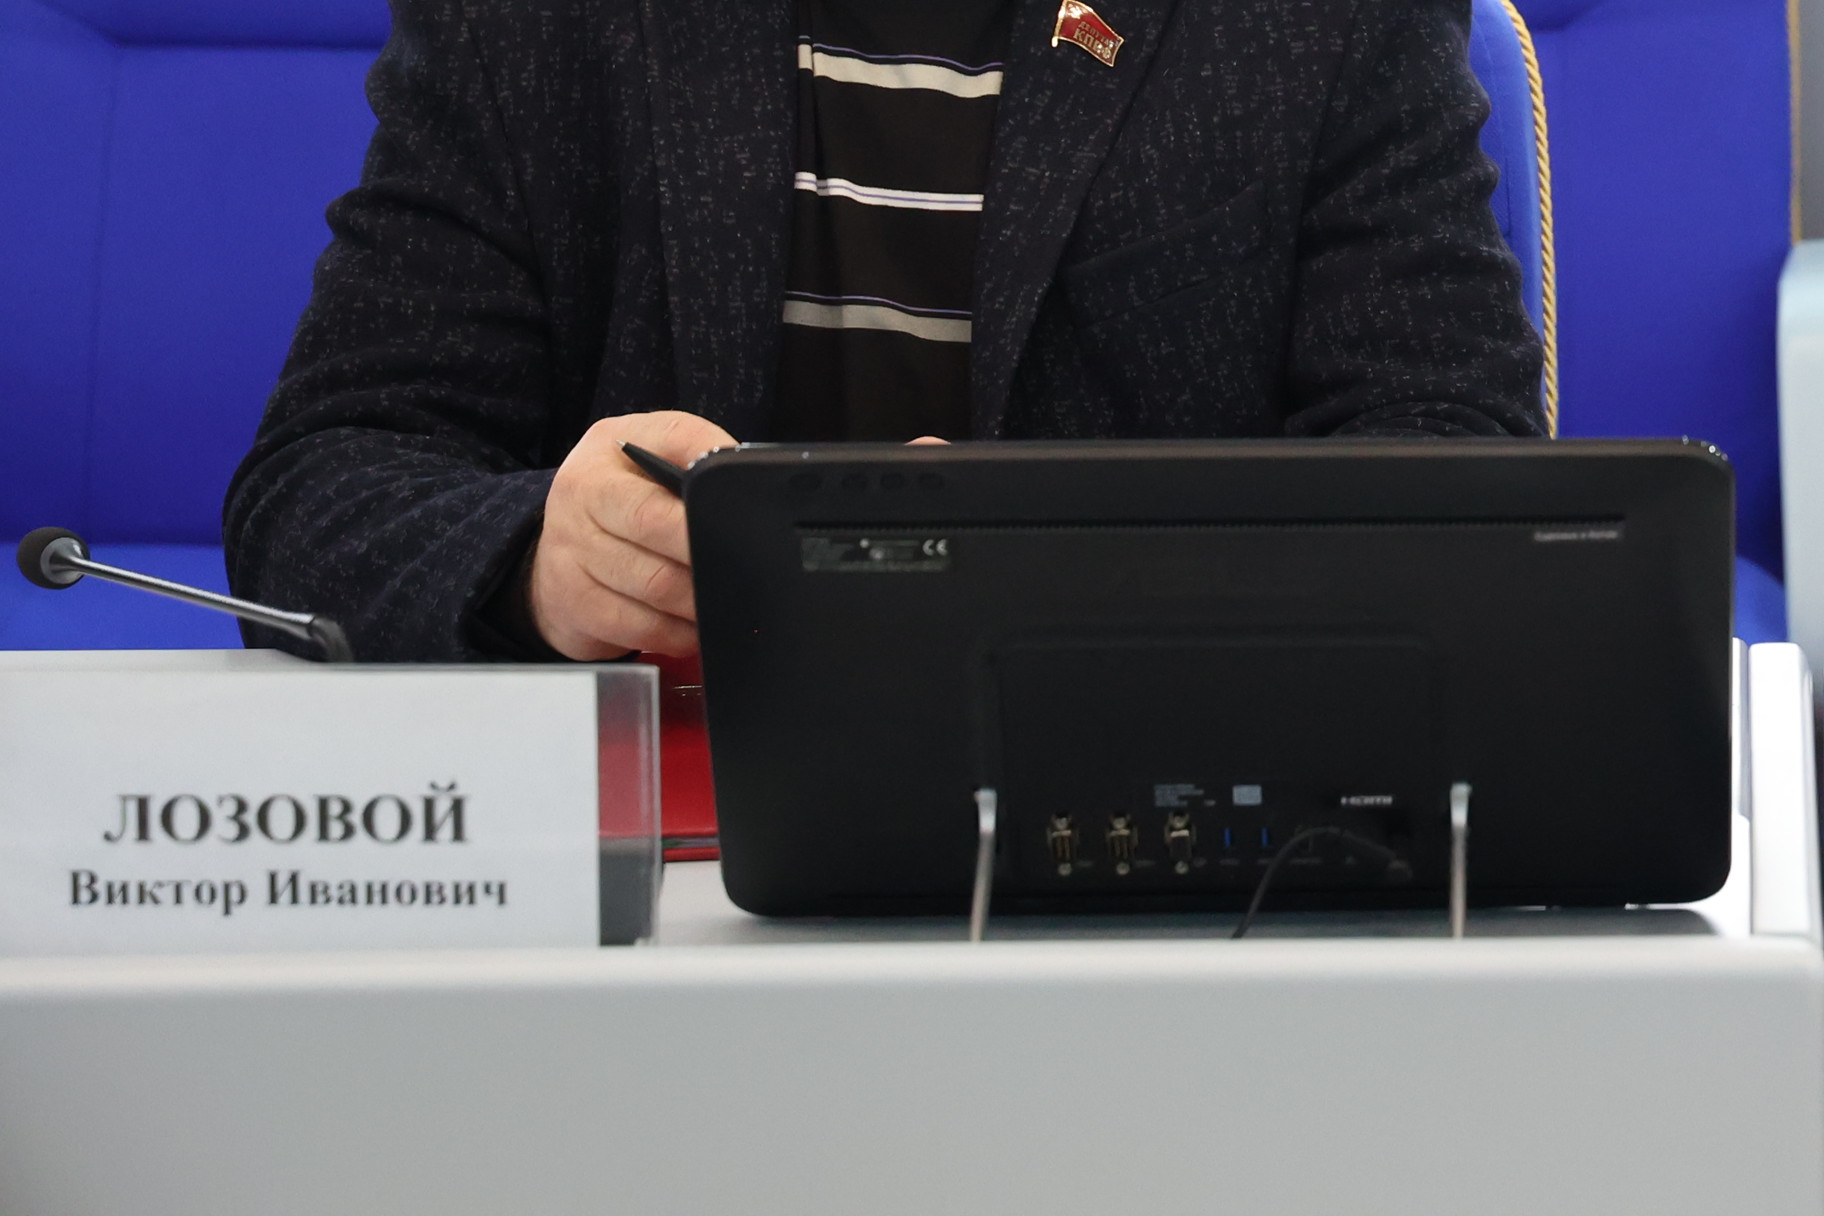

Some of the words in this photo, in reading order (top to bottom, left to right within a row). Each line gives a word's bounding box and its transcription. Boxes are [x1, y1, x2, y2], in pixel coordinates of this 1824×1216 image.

[1073, 27, 1112, 59] КПРФ
[102, 781, 468, 844] ЛОЗОВОЙ
[69, 869, 248, 918] Виктор
[266, 870, 508, 908] Иванович
